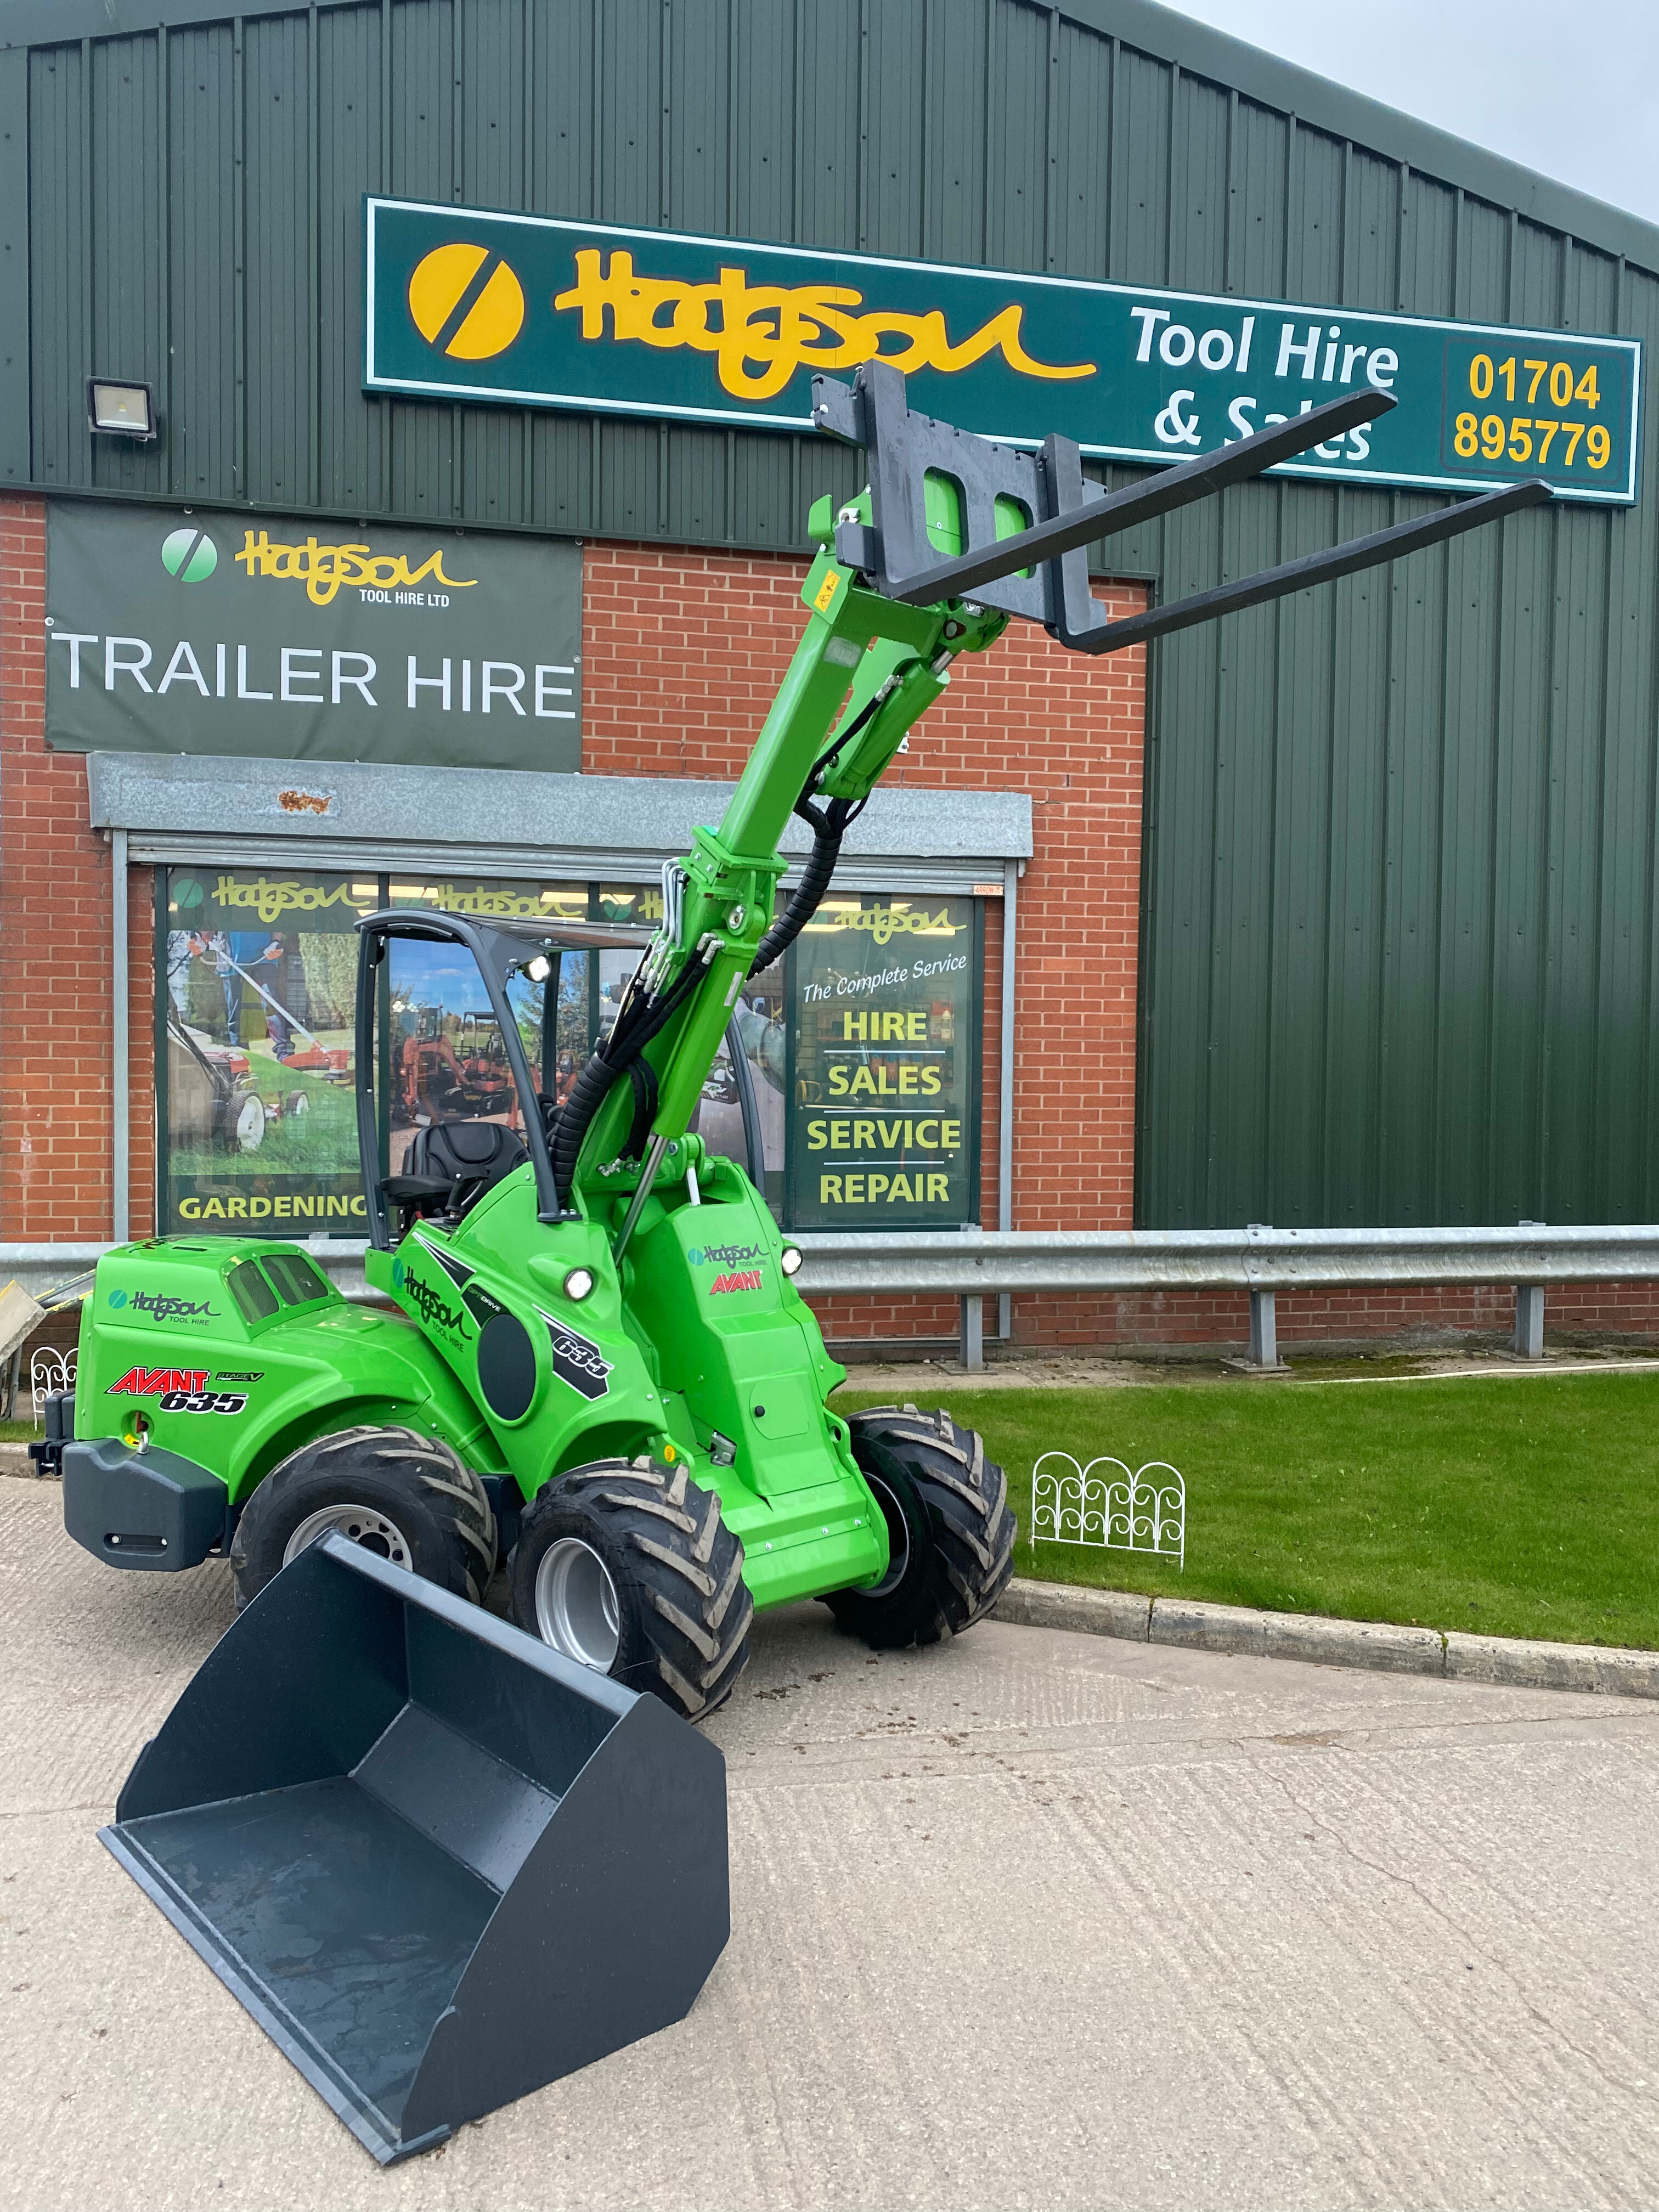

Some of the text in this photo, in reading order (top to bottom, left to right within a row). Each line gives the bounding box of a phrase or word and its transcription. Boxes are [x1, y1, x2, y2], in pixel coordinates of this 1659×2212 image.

[555, 249, 1096, 399] Hodgson
[1131, 307, 1398, 387] Tool Hire
[1470, 354, 1600, 409] 01704
[1154, 390, 1201, 445] &
[1454, 412, 1611, 469] 895779
[235, 530, 478, 605] Hodgson
[359, 589, 449, 607] TOOL HIRE LTD
[51, 633, 575, 718] TRAILER HIRE
[211, 876, 370, 923] Hodgson
[834, 902, 967, 945] Hodgson
[804, 953, 967, 1003] The Complete Service
[844, 1012, 927, 1041] HIRE
[829, 1065, 941, 1095] SALES
[808, 1120, 961, 1150] SERVICE
[820, 1173, 950, 1204] REPAIR
[704, 1243, 770, 1269] Hodgson
[404, 1266, 472, 1340] Hodgson
[709, 1270, 762, 1295] AVANT
[129, 1291, 222, 1322] Hodgson
[432, 1321, 464, 1353] TOOL HIRE
[552, 1335, 615, 1379] 635
[104, 1366, 210, 1396] AVANT
[159, 1390, 250, 1415] 635
